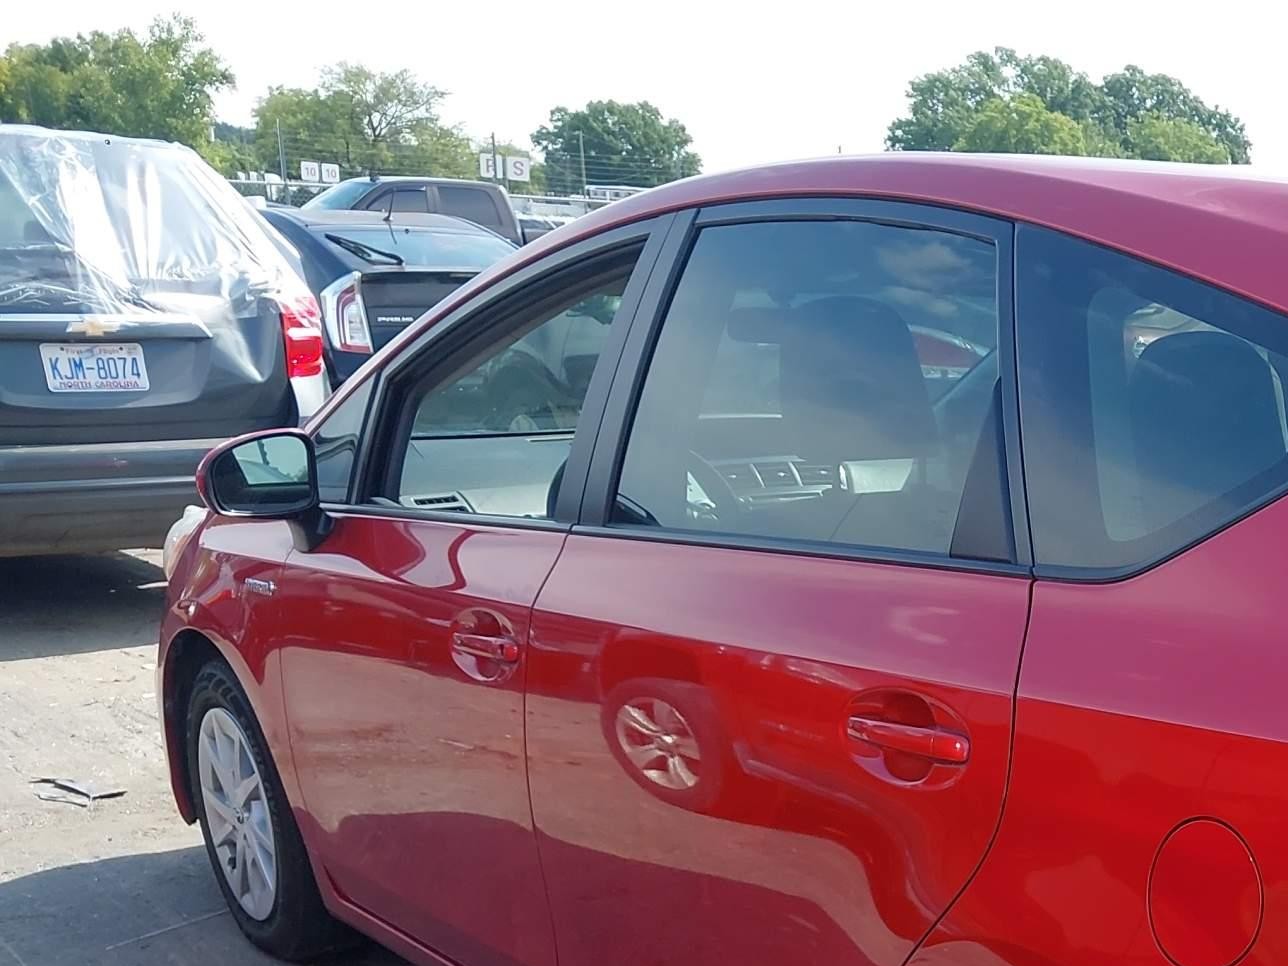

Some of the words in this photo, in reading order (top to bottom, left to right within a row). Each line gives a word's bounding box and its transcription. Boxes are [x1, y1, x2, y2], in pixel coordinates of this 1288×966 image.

[305, 167, 316, 177] 10
[326, 168, 337, 179] 10
[512, 160, 524, 177] S
[49, 357, 141, 380] KJM-8074
